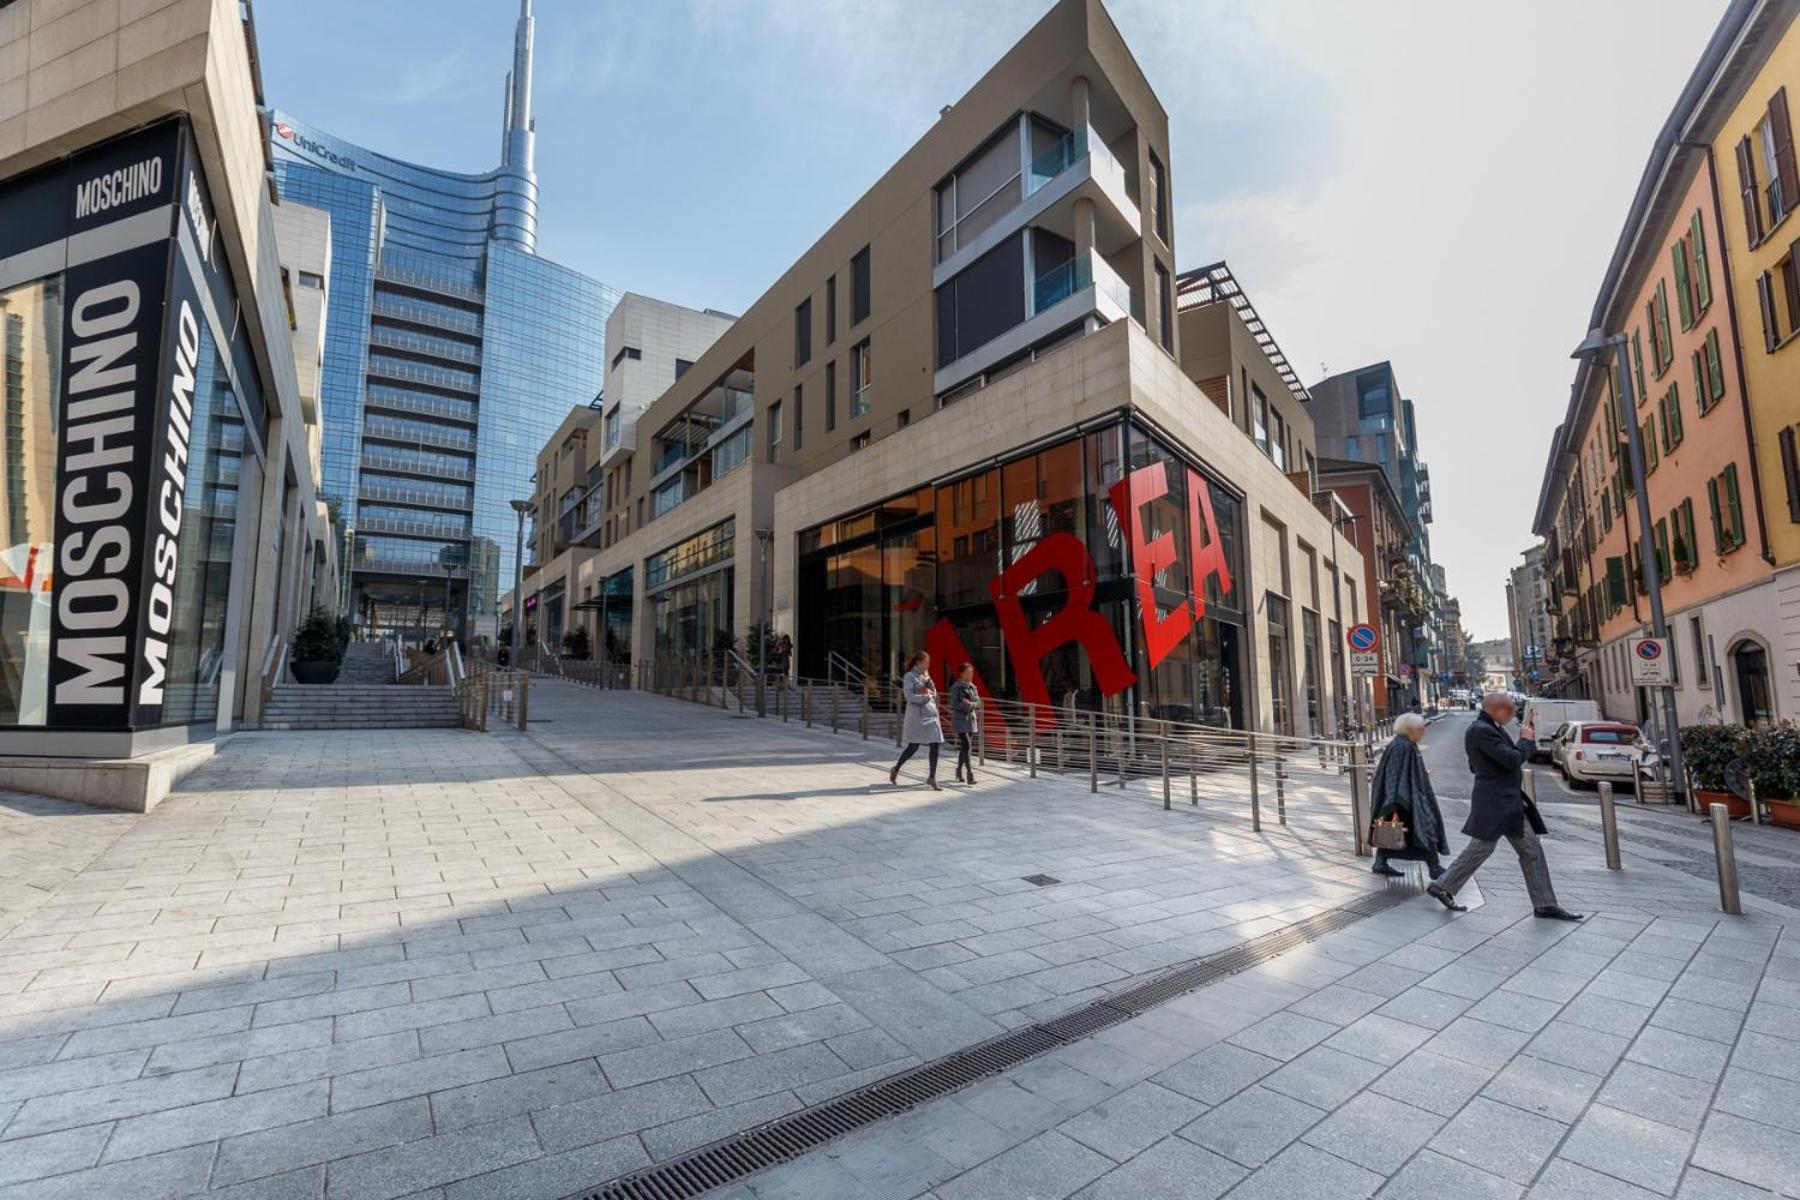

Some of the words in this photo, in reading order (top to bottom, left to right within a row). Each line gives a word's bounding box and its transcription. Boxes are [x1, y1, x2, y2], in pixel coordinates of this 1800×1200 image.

[76, 156, 162, 219] MOSCHINO
[294, 133, 357, 172] UniCredit
[55, 279, 141, 704] MOSCHINO
[139, 300, 199, 704] MOSCHINO
